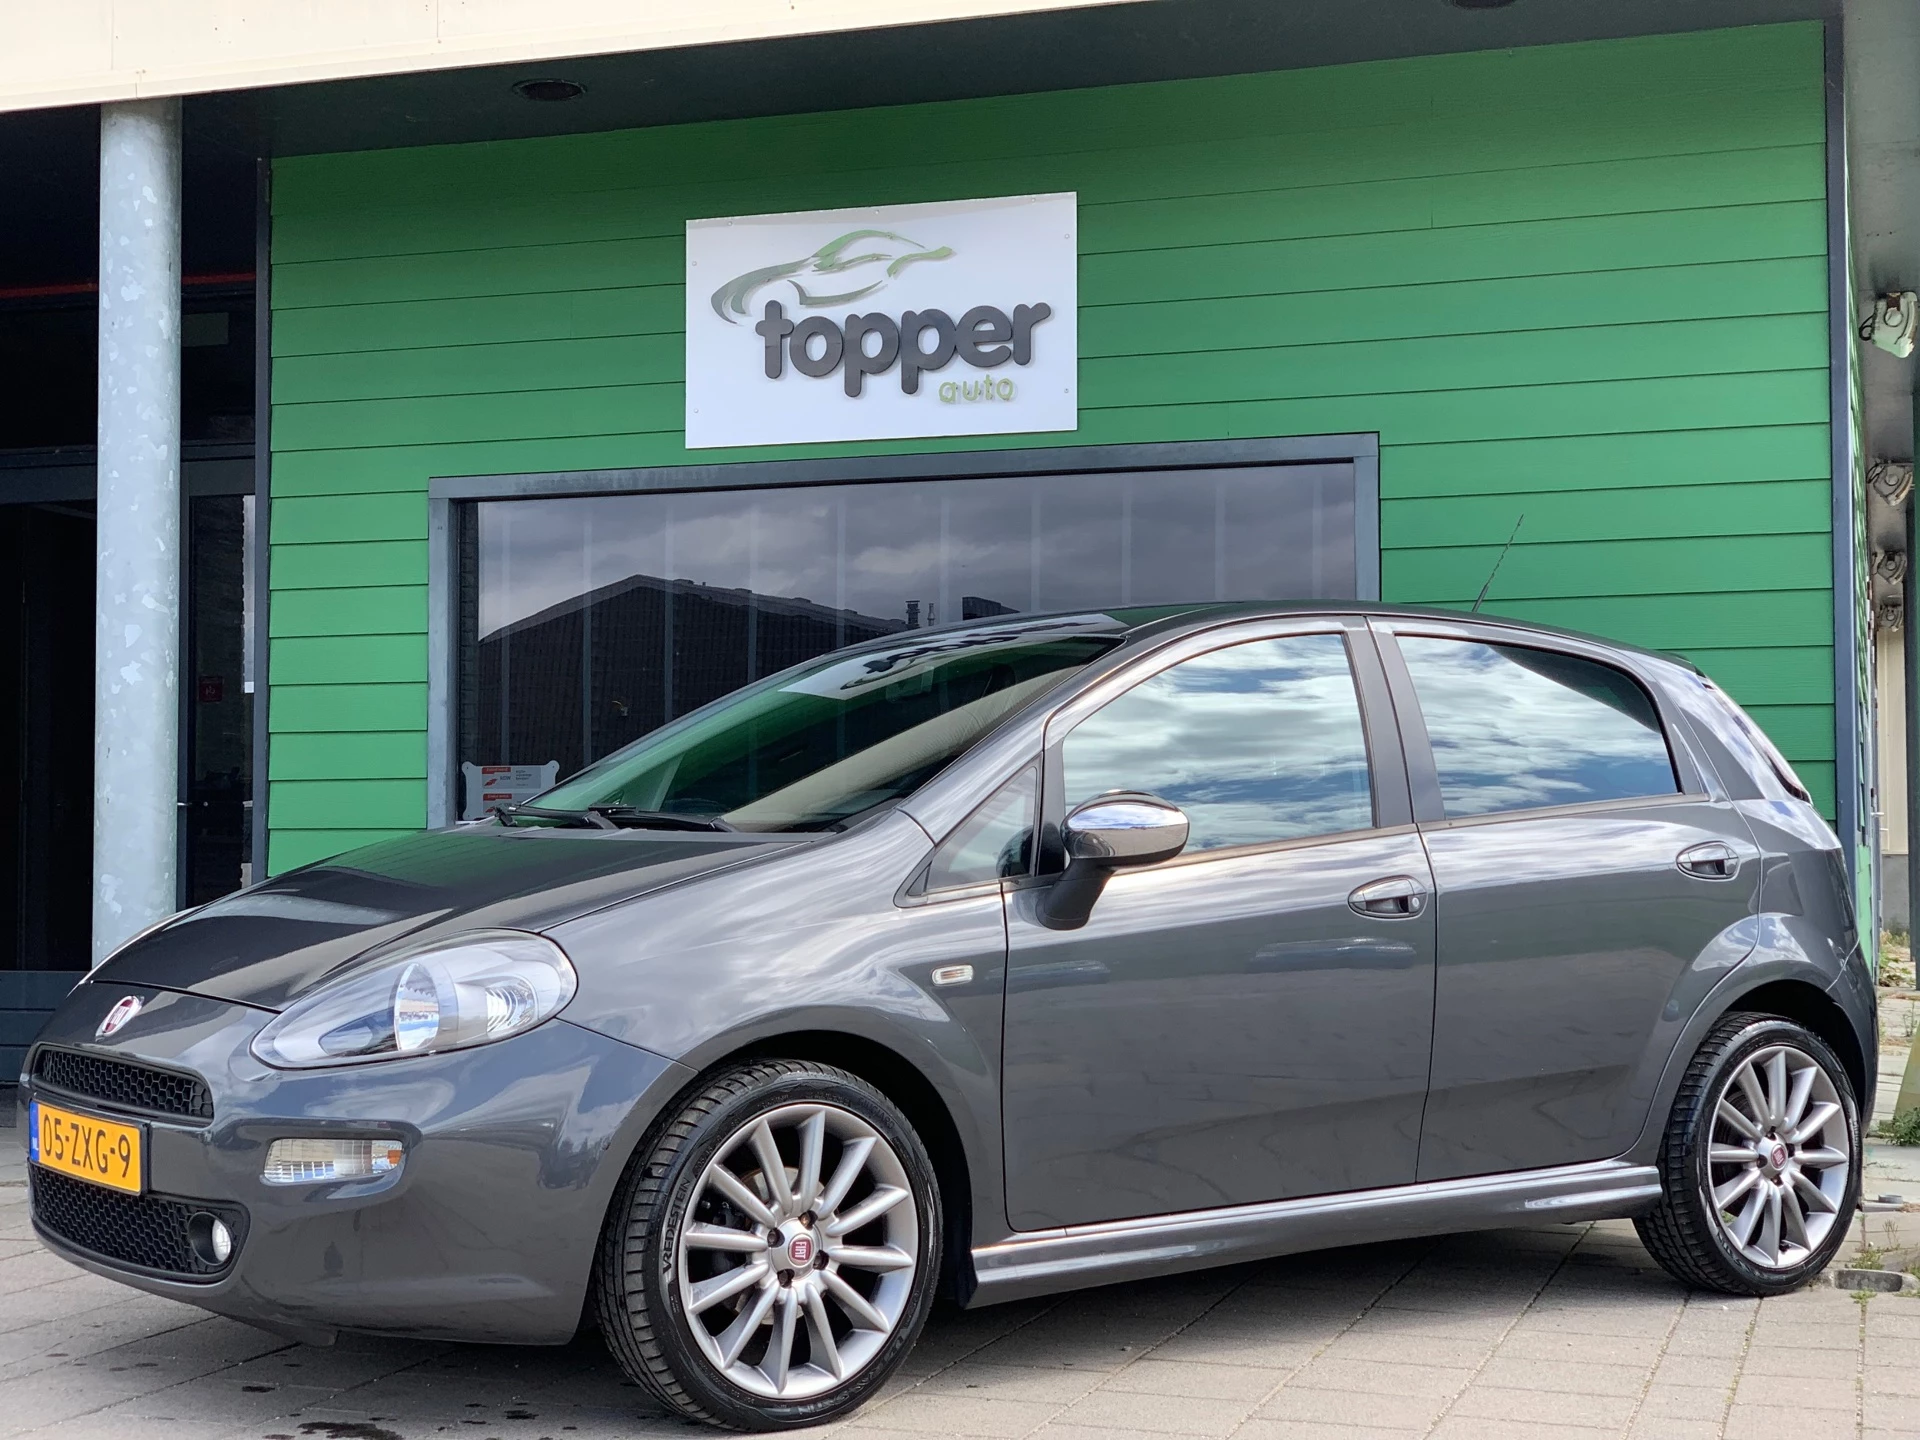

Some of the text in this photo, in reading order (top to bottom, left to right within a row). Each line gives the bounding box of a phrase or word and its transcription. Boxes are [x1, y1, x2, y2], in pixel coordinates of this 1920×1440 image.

[755, 300, 1051, 397] topper
[939, 375, 1014, 402] auto
[43, 1113, 131, 1178] 05-ZXG-9
[663, 1177, 690, 1275] VREDESTEIN
[795, 1241, 807, 1259] FIAT
